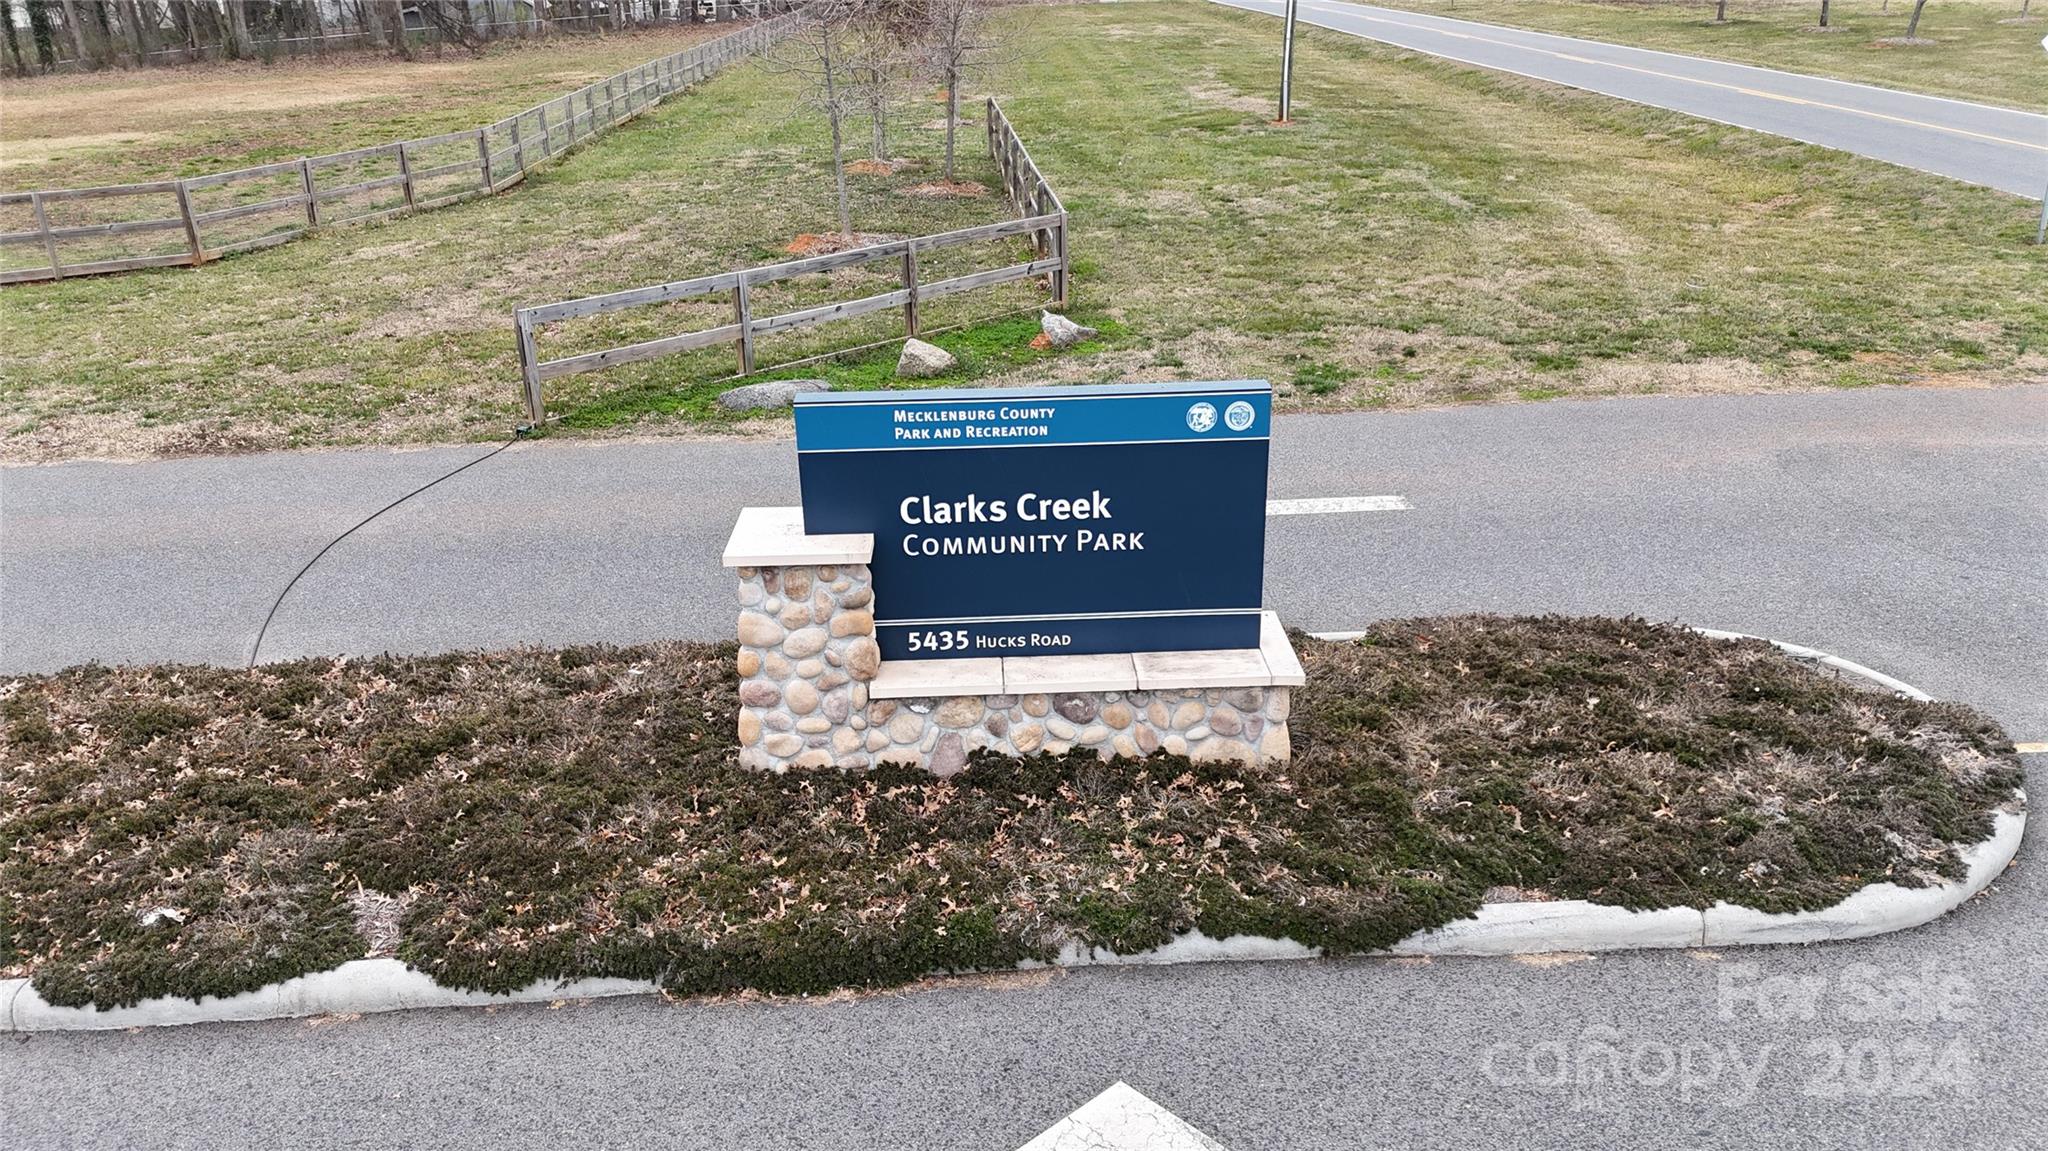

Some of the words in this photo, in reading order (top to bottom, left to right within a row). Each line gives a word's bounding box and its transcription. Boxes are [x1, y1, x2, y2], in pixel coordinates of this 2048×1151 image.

[893, 407, 996, 423] MECKLENBURG
[1000, 406, 1056, 420] COUNTY
[894, 427, 931, 440] PARK
[933, 427, 962, 439] AND
[965, 424, 1048, 438] RECREATION
[899, 493, 1008, 526] Clarks
[1016, 490, 1113, 521] Creek
[902, 532, 1068, 557] COMMUNITY
[1077, 529, 1145, 552] PARK
[907, 630, 969, 652] 5435
[976, 634, 1027, 649] HUCKS
[1030, 633, 1072, 647] ROAD
